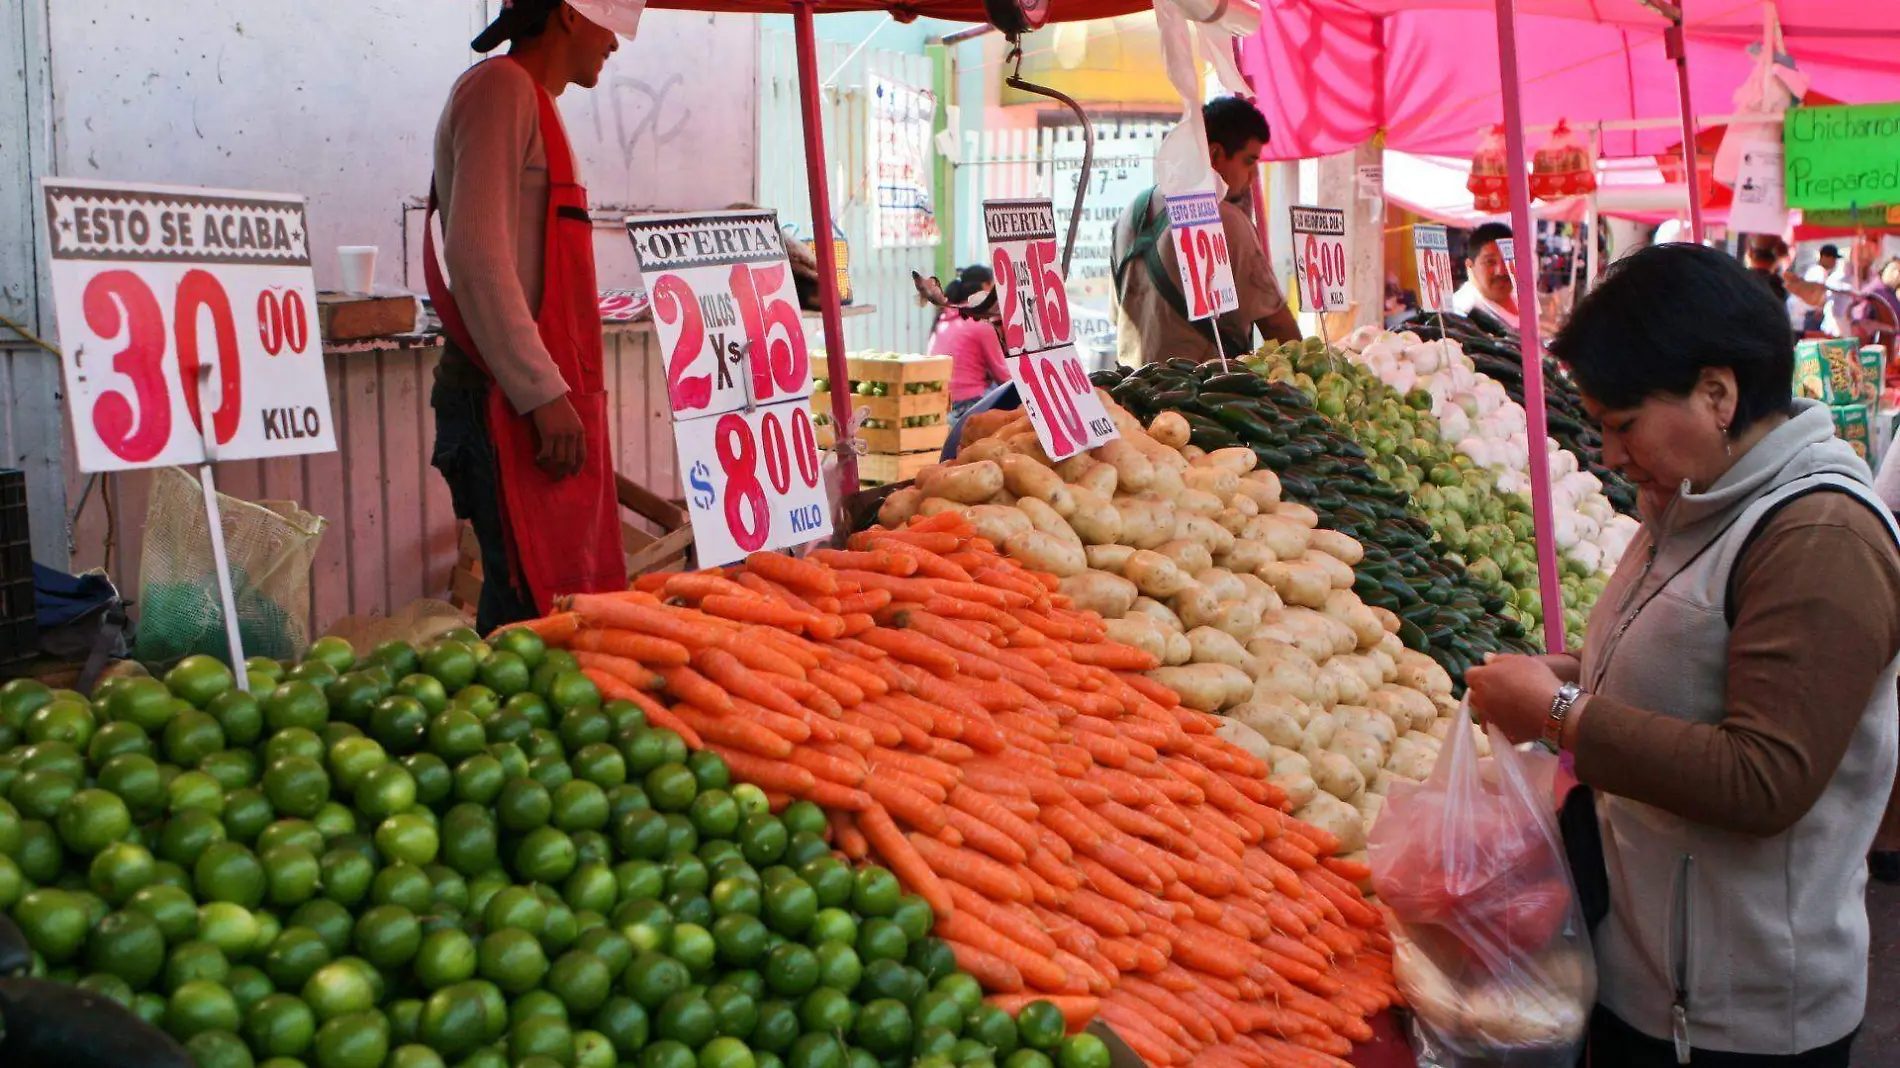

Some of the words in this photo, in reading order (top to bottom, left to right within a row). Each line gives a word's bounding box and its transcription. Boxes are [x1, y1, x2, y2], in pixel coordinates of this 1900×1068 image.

[991, 212, 1048, 234] OFERTA
[1171, 205, 1188, 222] ESTO
[1189, 203, 1198, 219] SE
[1197, 201, 1216, 219] ACABA
[74, 207, 150, 244] ESTO
[161, 211, 193, 246] SE
[203, 214, 292, 250] ACABA
[648, 227, 773, 259] OFERTA
[993, 247, 1025, 349] 2
[1025, 240, 1070, 343] 15
[1330, 292, 1344, 305] KILO
[654, 274, 712, 411] 2
[699, 293, 736, 328] KILOS
[729, 262, 809, 400] 15
[82, 269, 242, 462] 30
[257, 289, 308, 356] 00
[262, 406, 320, 440] KILO
[1089, 417, 1113, 437] KILO
[790, 504, 822, 534] KILO
